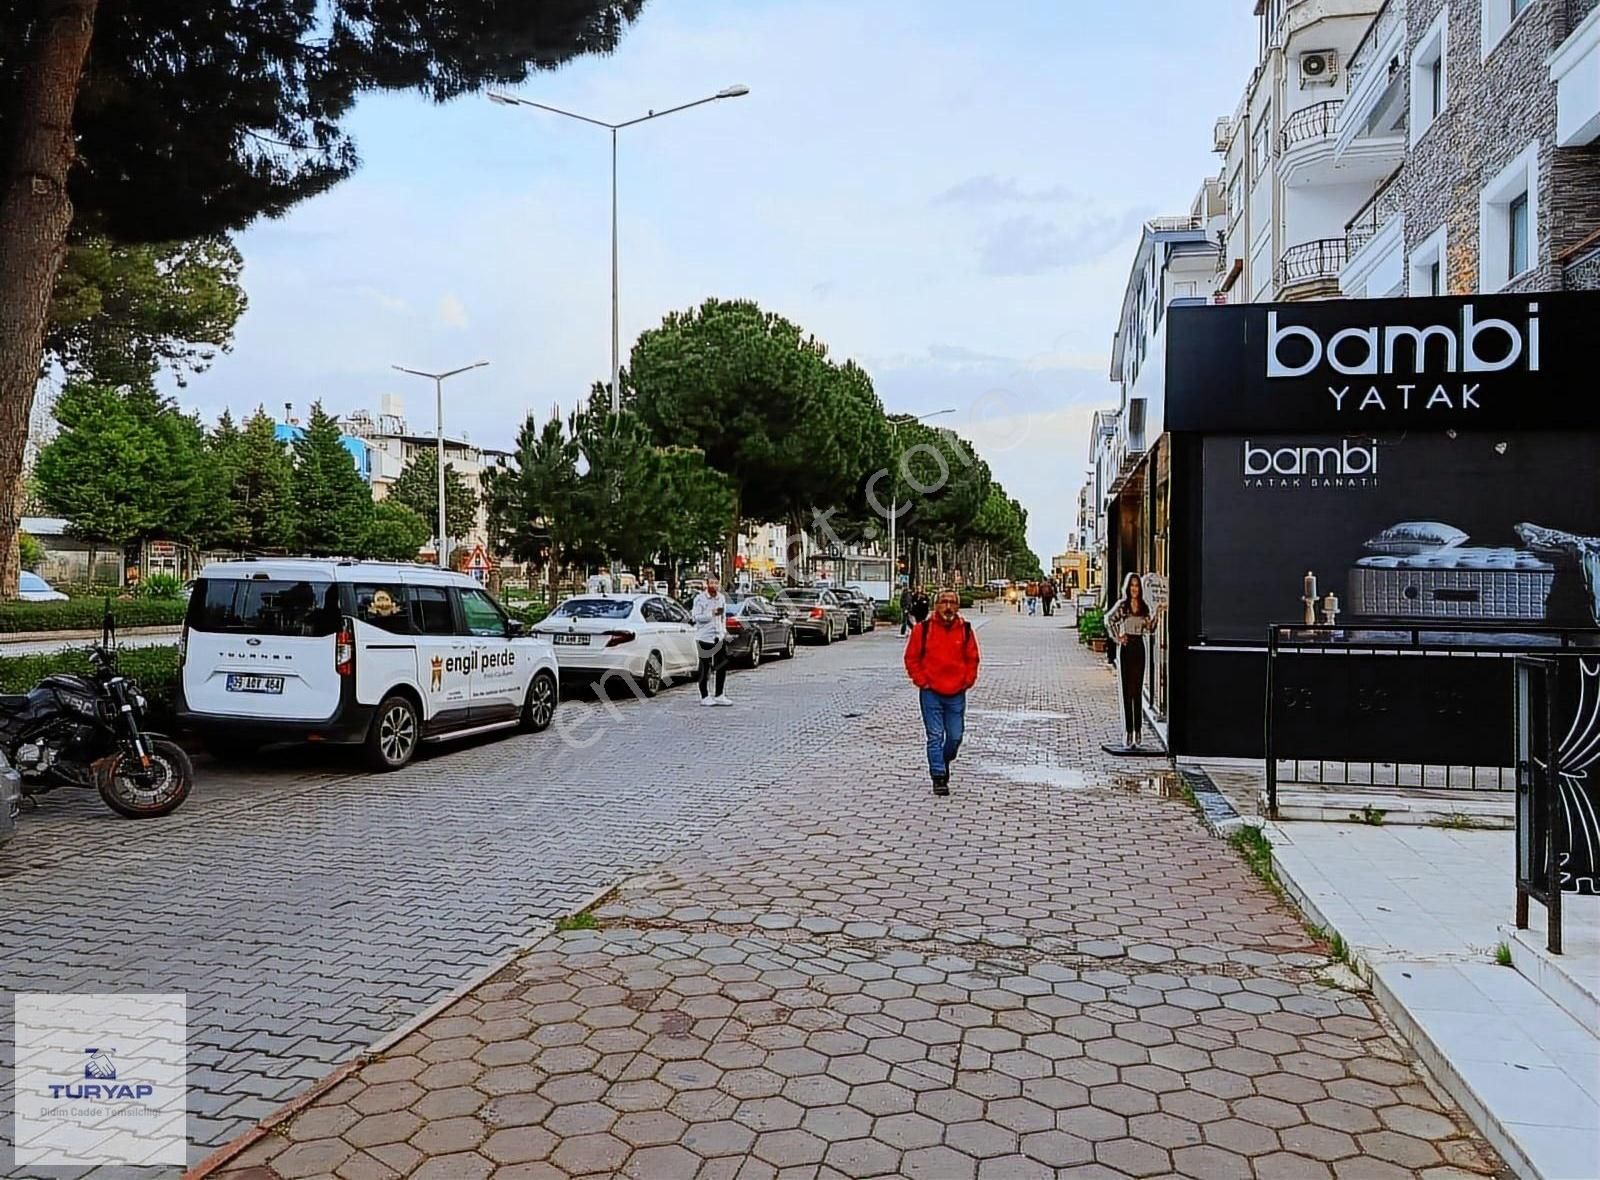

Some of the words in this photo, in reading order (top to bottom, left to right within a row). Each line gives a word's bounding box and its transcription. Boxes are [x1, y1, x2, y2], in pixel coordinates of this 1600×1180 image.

[1267, 302, 1540, 377] bambi
[1328, 384, 1480, 411] YATAK
[1244, 439, 1377, 475] bambi
[1243, 478, 1300, 488] YATAK
[445, 650, 478, 675] engil
[481, 647, 515, 672] perde
